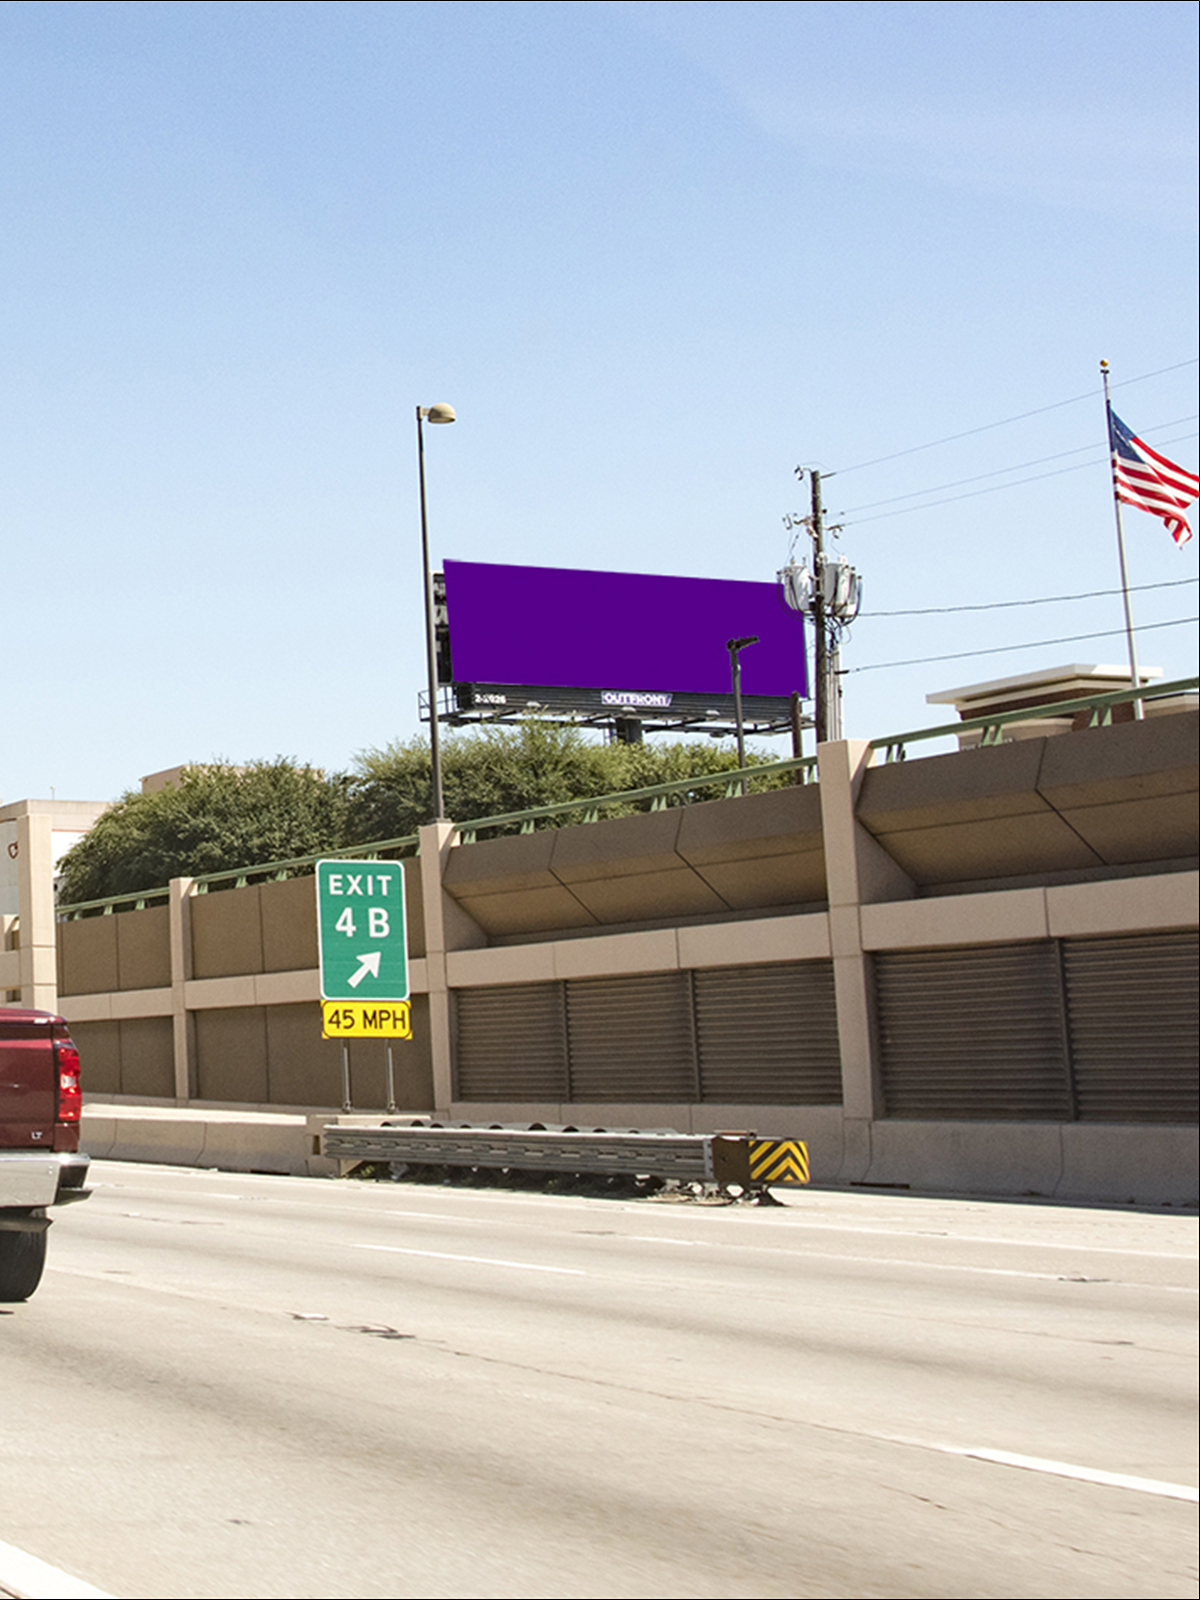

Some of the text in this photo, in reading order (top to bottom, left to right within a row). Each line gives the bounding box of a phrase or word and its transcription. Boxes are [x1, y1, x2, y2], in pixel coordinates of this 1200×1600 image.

[604, 691, 668, 707] OUTFRONT
[328, 874, 392, 896] EXIT
[335, 907, 390, 938] 4 B
[328, 1009, 406, 1030] 45 MPH
[31, 1131, 43, 1140] LT
